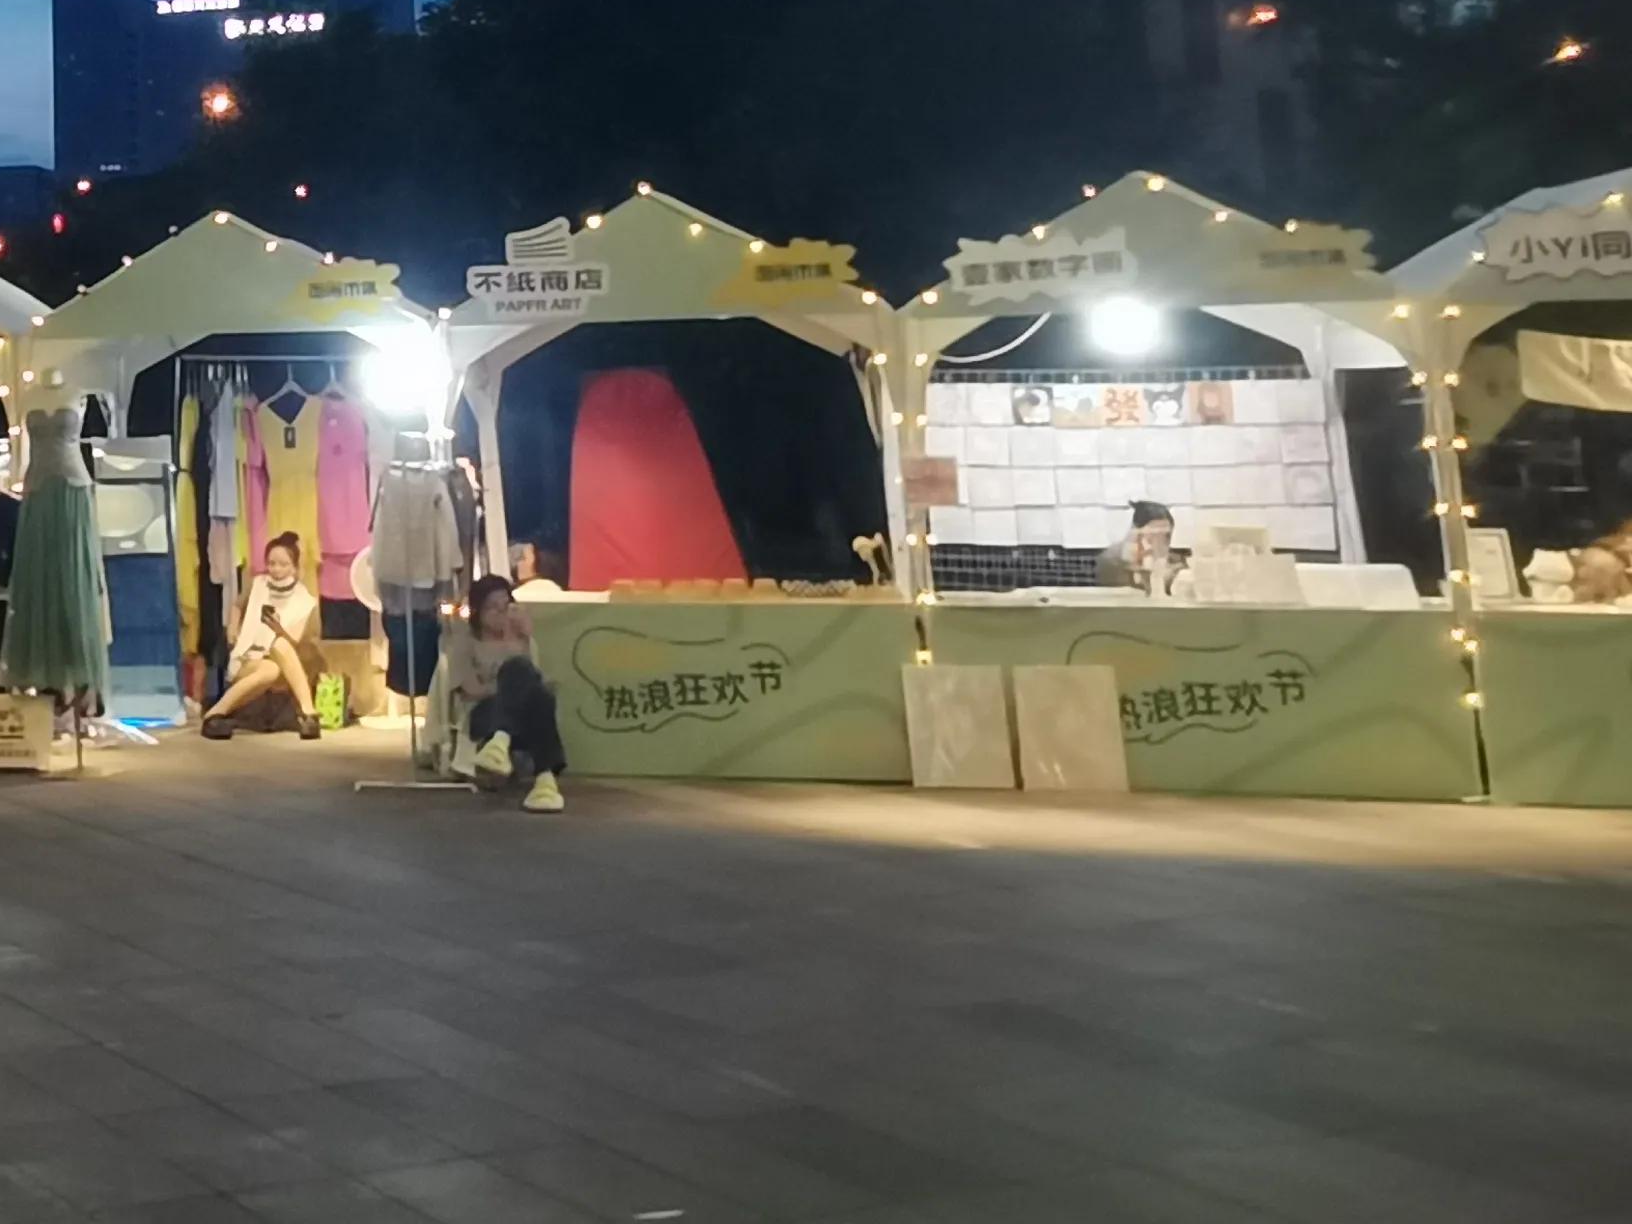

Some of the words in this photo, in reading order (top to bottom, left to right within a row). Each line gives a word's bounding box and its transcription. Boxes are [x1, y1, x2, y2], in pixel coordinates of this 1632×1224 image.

[604, 661, 782, 720] 热浪狂欢节
